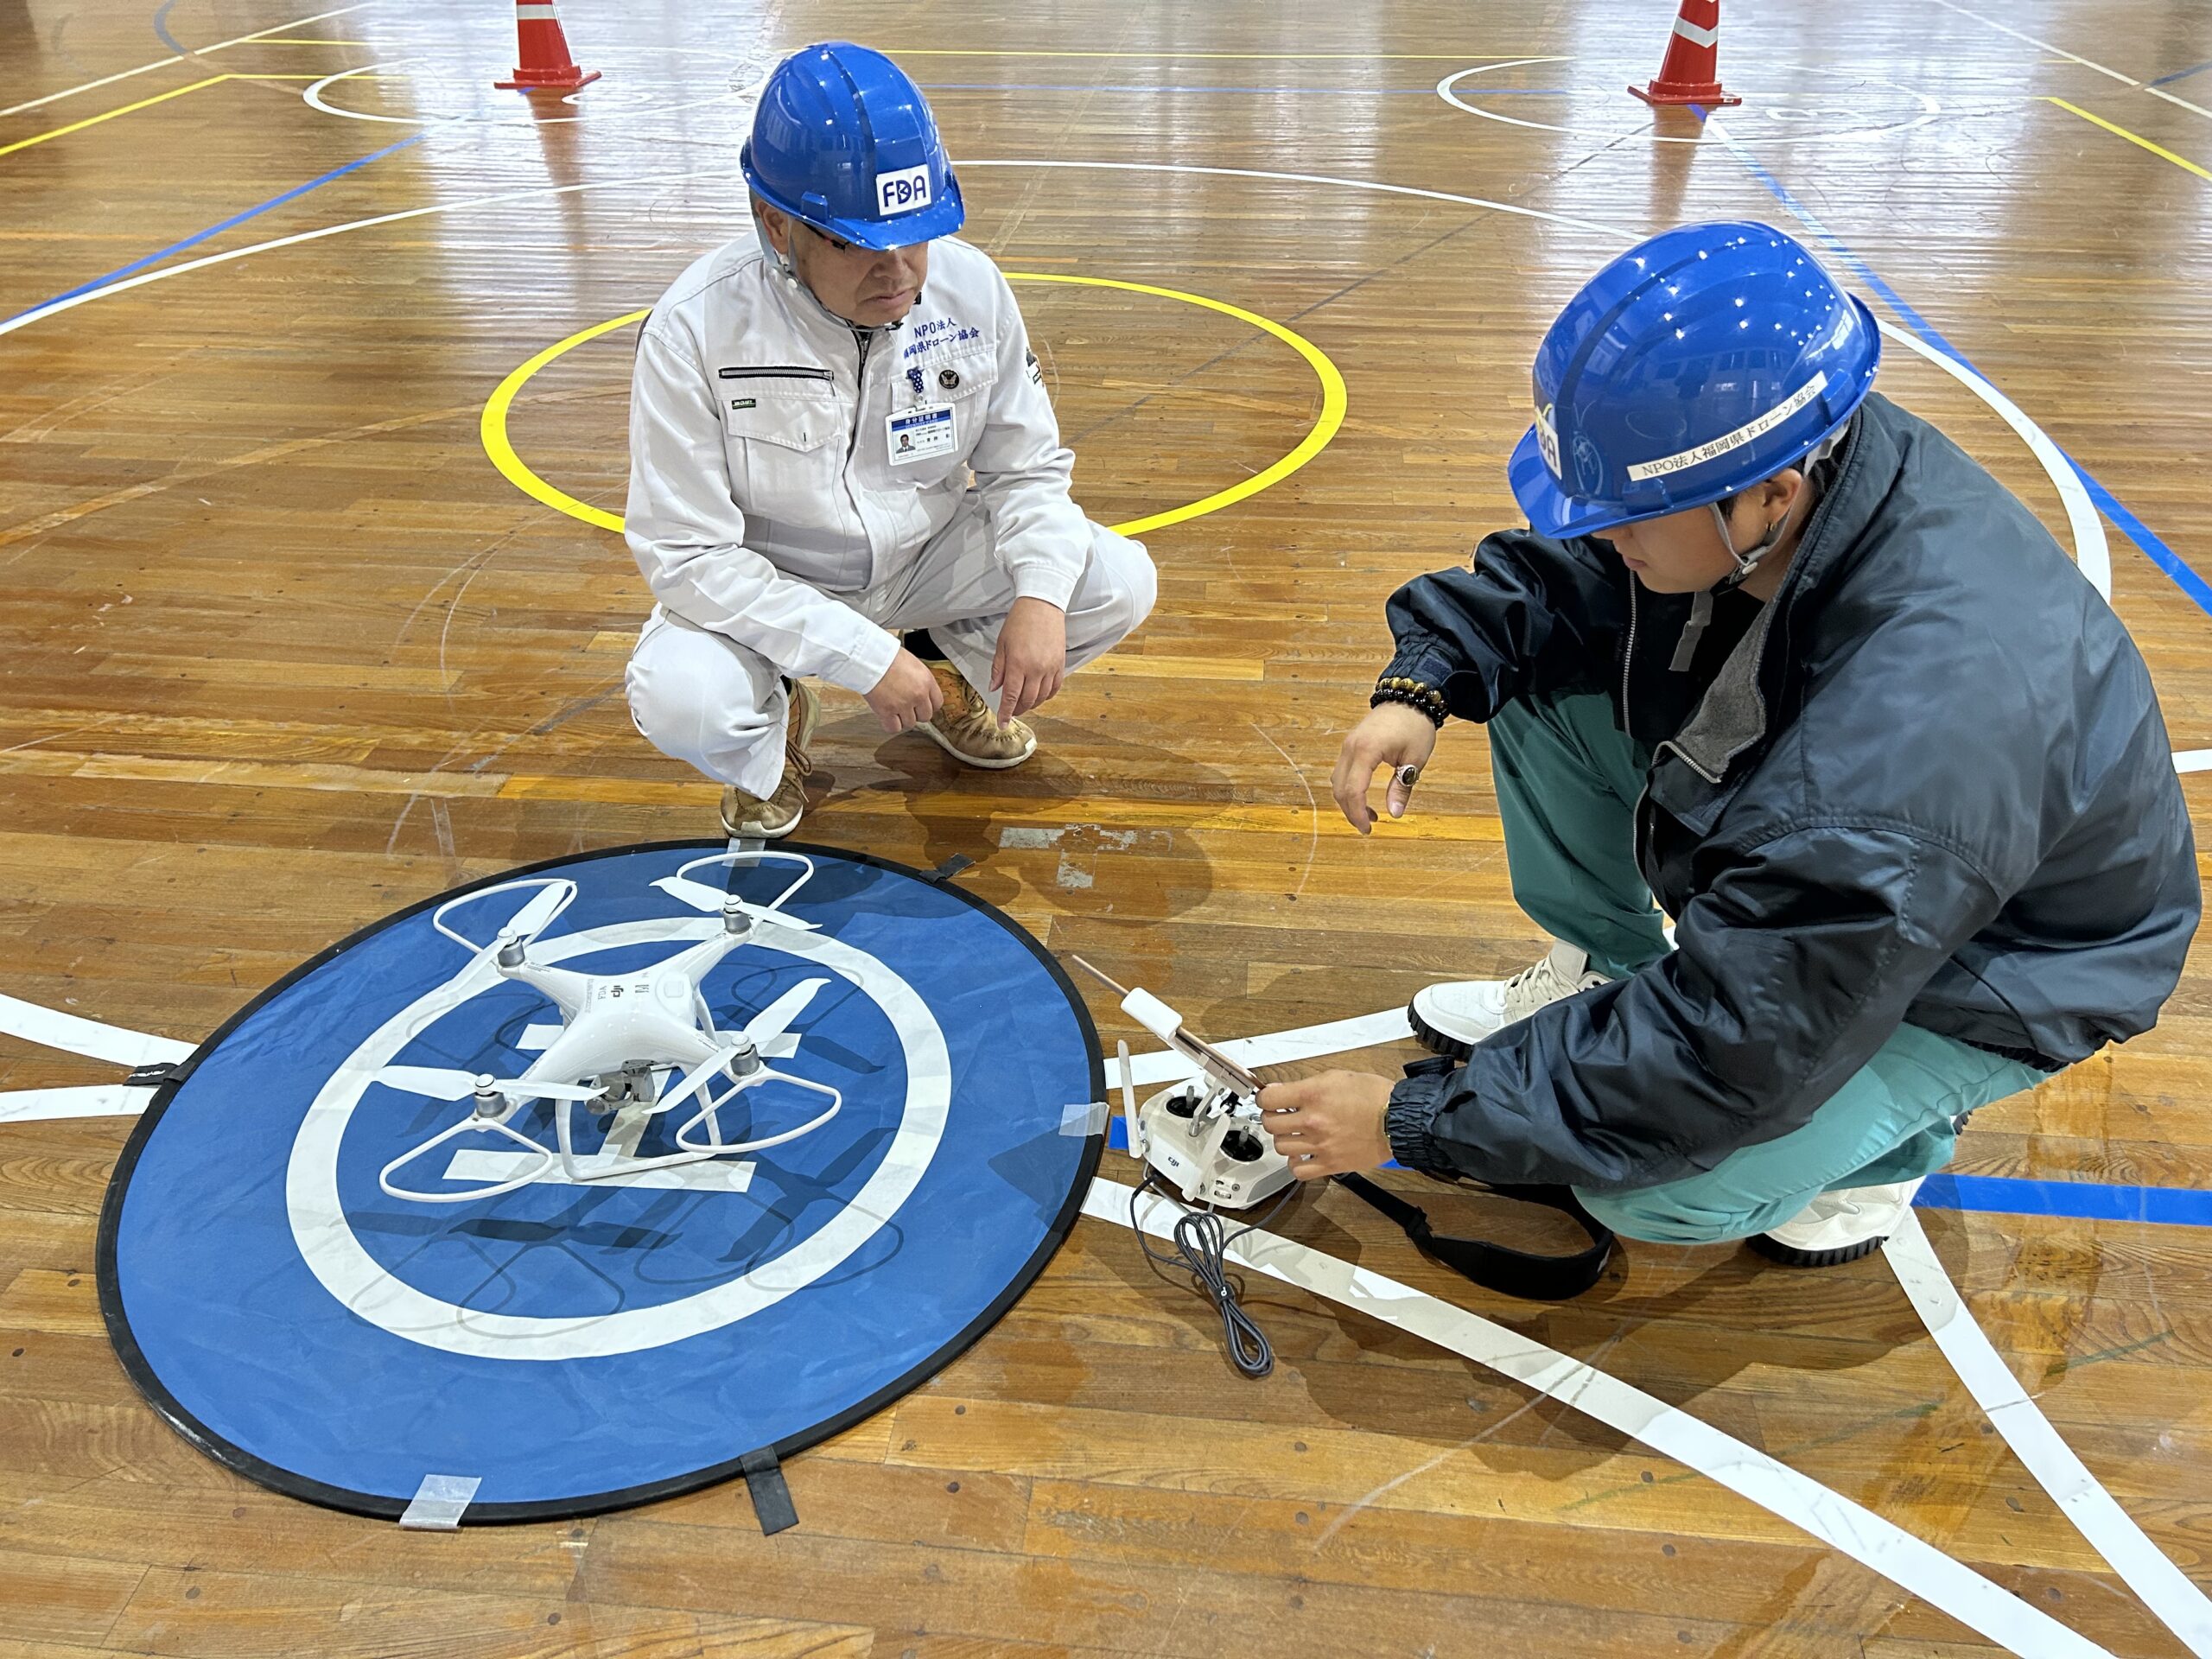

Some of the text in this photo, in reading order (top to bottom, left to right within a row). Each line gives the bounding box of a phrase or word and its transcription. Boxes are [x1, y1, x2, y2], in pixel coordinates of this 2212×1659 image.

[882, 175, 927, 207] FDA
[913, 317, 957, 339] NPO法人
[1643, 385, 1816, 476] NPO法人福岡県ドローン協会
